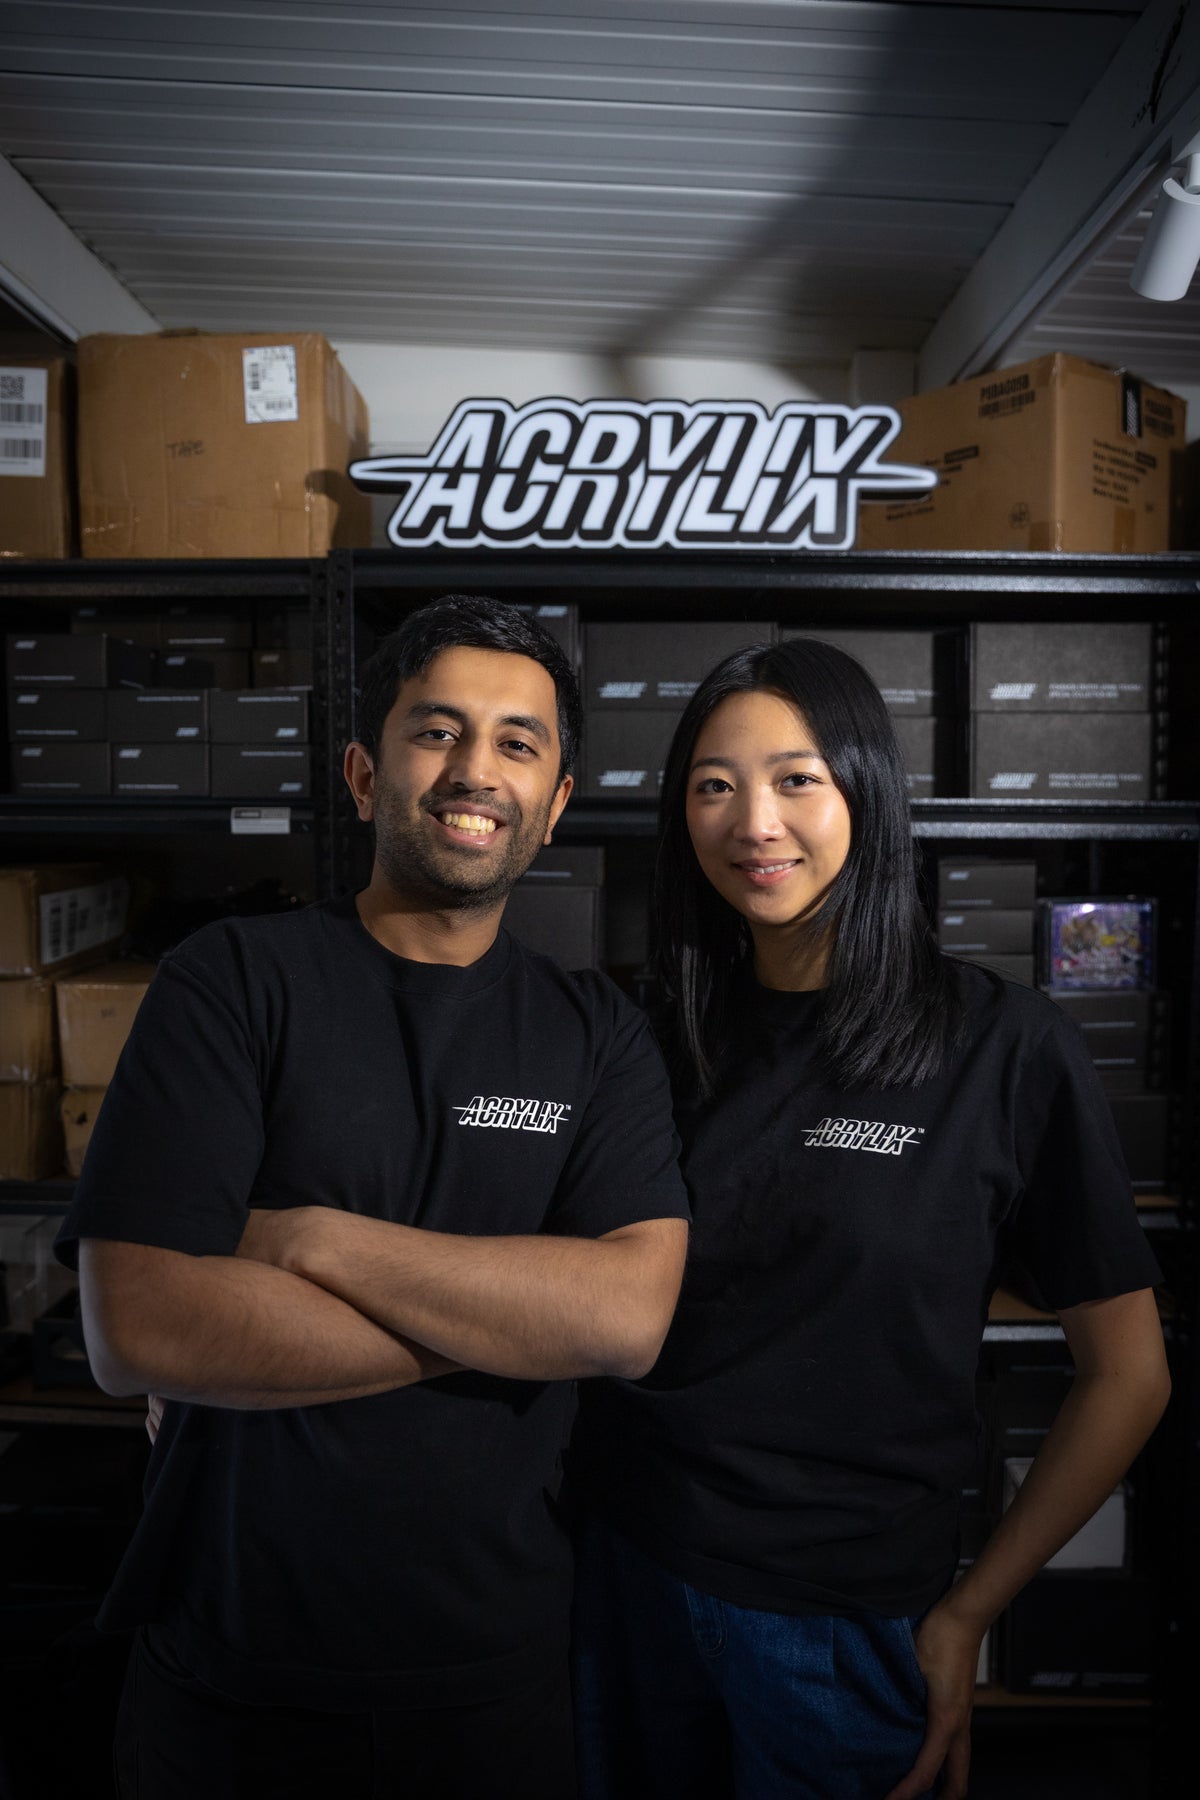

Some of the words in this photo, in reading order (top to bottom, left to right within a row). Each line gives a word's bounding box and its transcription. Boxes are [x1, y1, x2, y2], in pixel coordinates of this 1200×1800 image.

[349, 398, 938, 549] ACRYLIX
[452, 1096, 568, 1134] ACRYLIX
[800, 1117, 921, 1156] ACRYLIX
